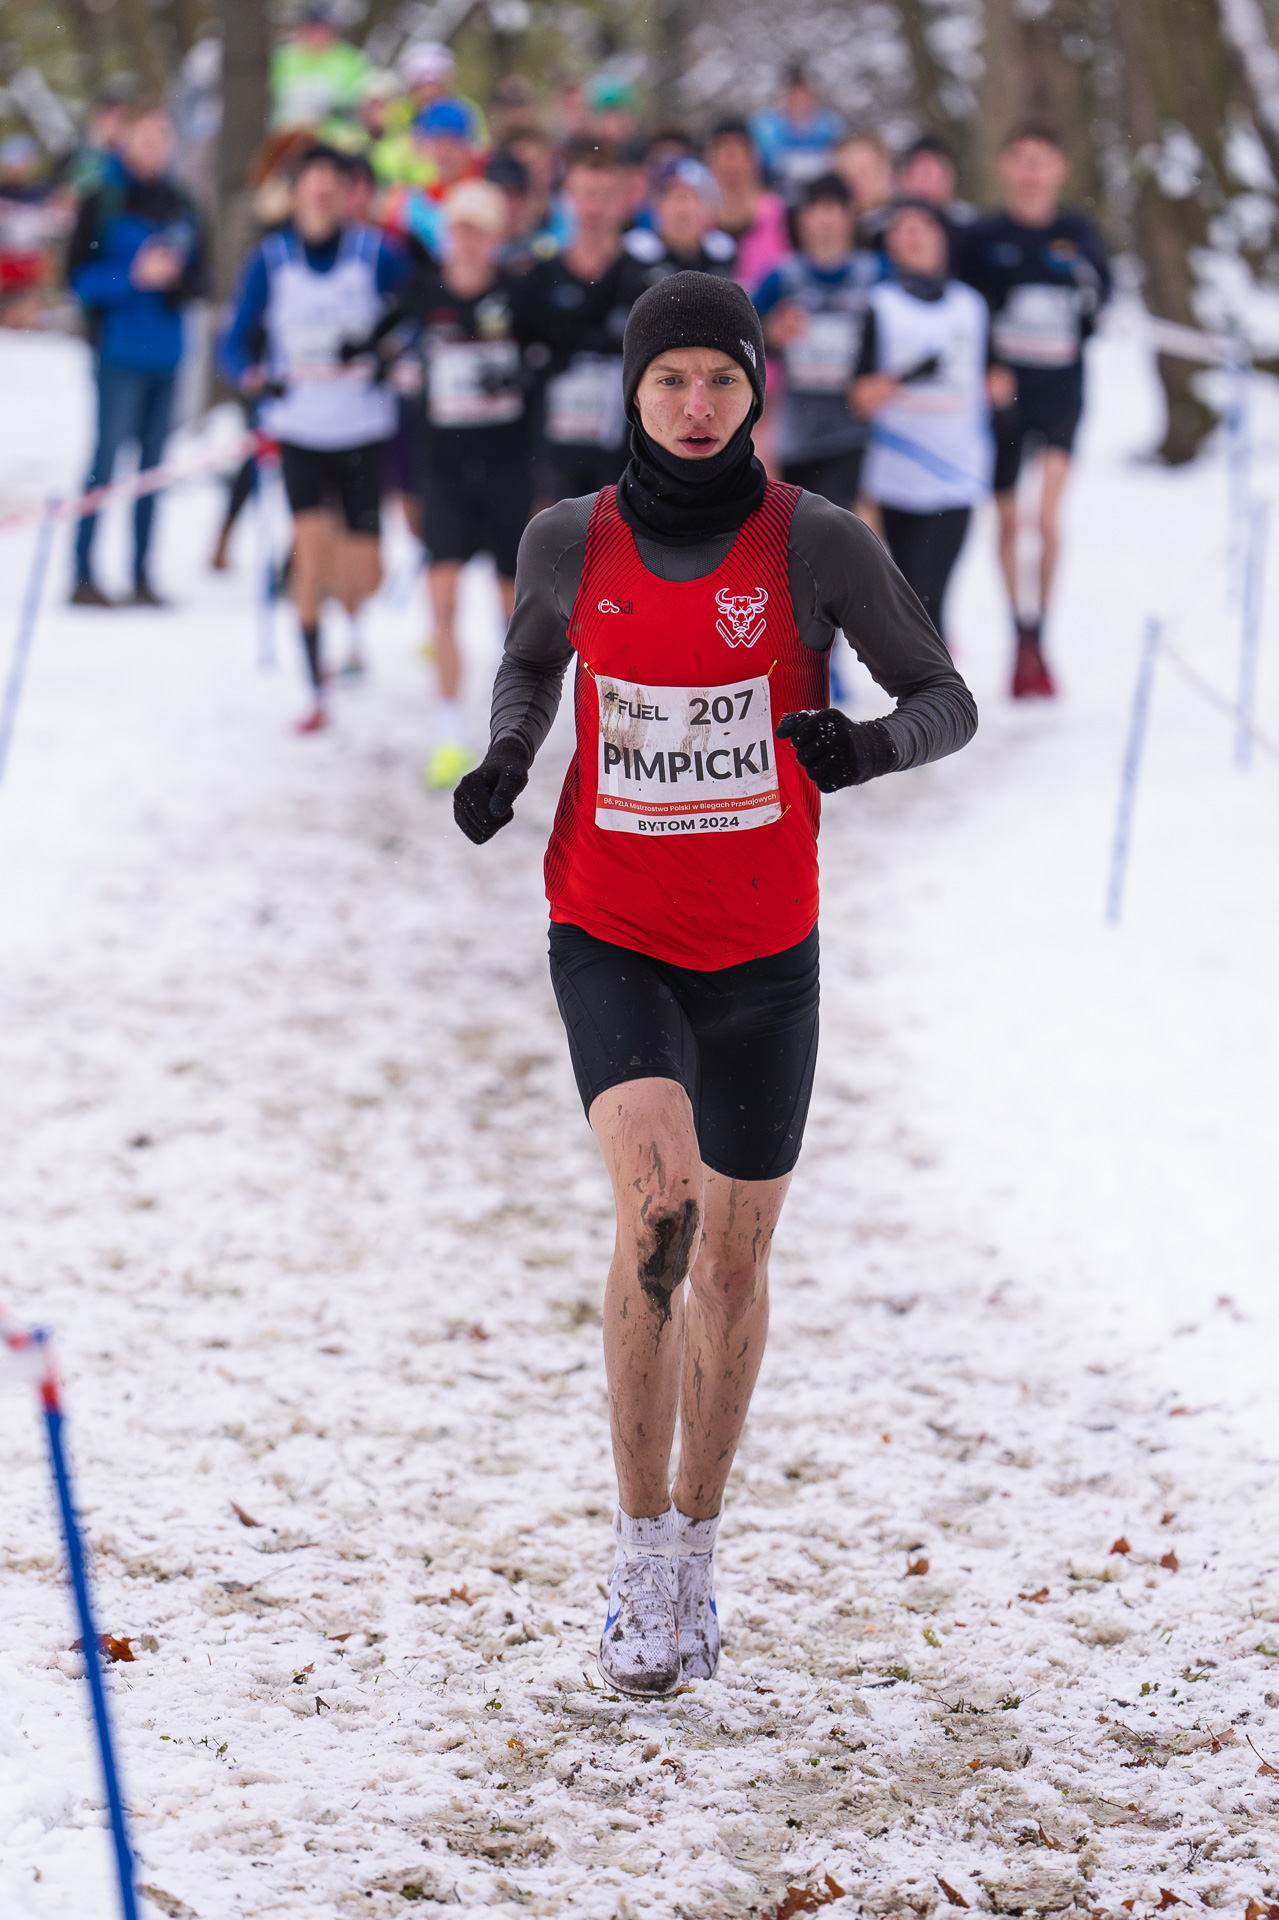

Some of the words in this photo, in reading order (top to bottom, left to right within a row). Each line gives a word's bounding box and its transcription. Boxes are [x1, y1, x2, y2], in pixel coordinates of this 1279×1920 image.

[618, 699, 669, 721] FUEL
[689, 689, 754, 726] 207
[603, 740, 770, 783] PIMPICKI
[614, 799, 629, 808] PZLA
[629, 802, 669, 812] Mistrzostwa
[670, 804, 691, 812] Polski
[700, 802, 730, 811] Biegach
[638, 819, 695, 832] BYTOM
[699, 816, 740, 829] 2024
